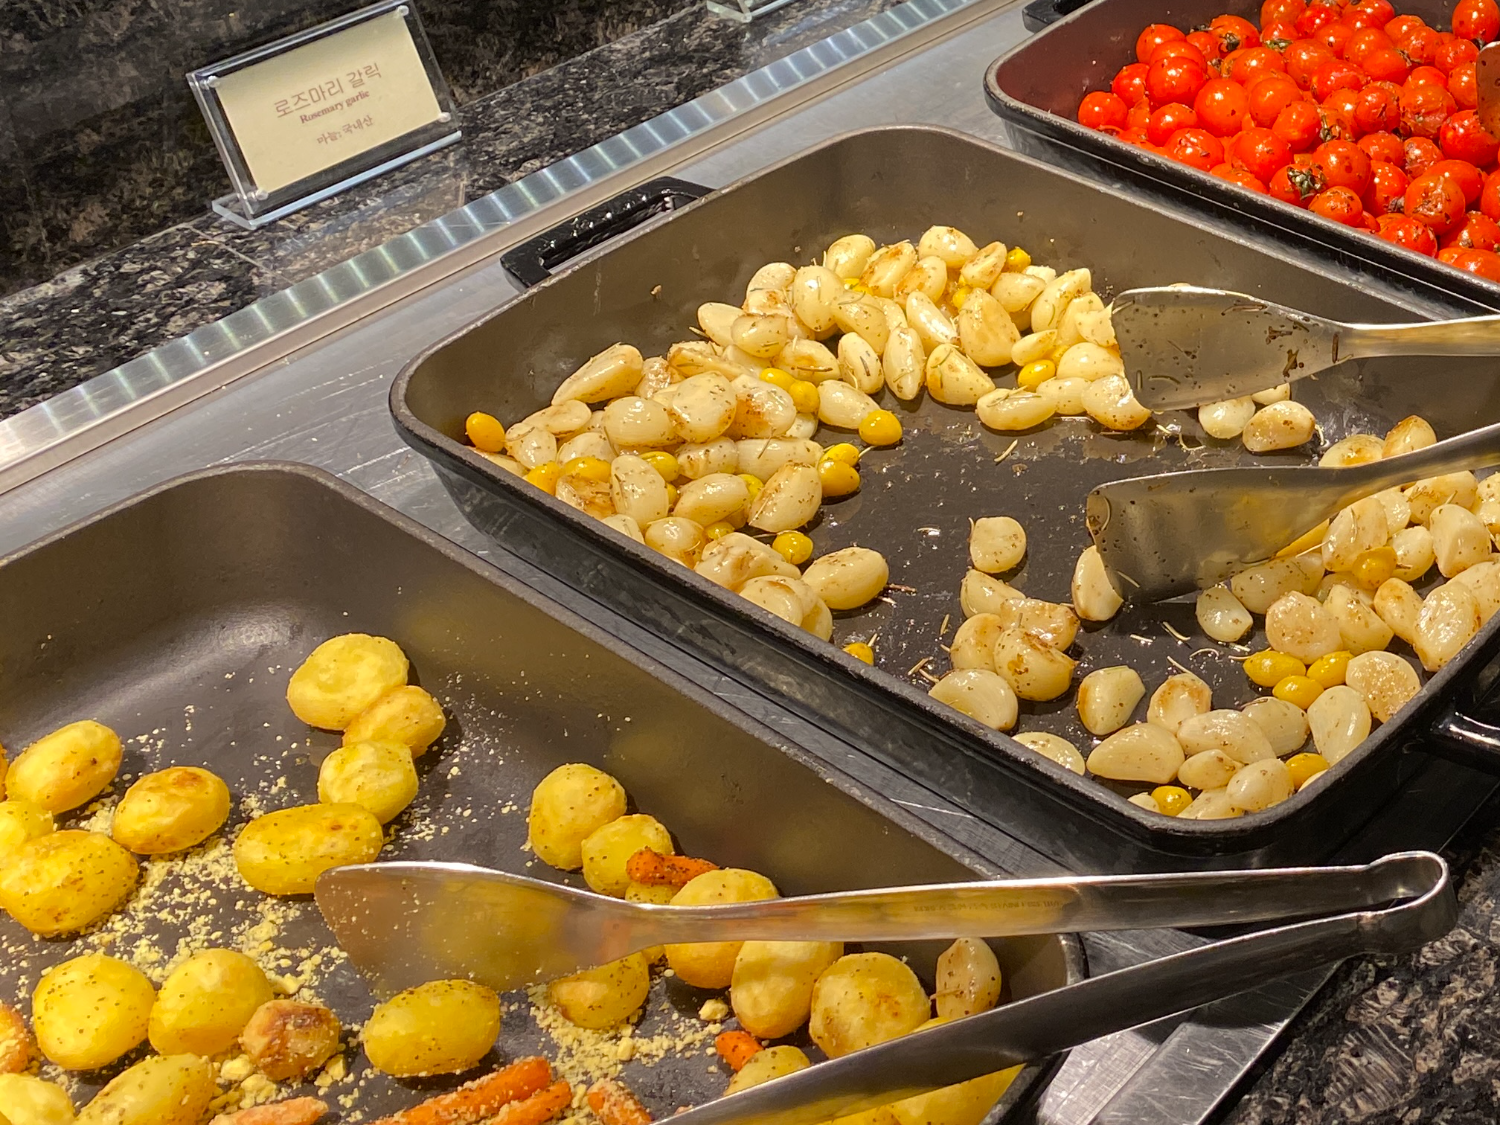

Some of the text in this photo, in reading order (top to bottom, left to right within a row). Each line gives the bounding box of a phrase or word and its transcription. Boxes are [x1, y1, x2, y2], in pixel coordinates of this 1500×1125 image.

[274, 62, 382, 119] 로즈마리 갈릭
[299, 89, 370, 124] Rosemary garlic
[316, 115, 374, 145] 마늘: 국내산
